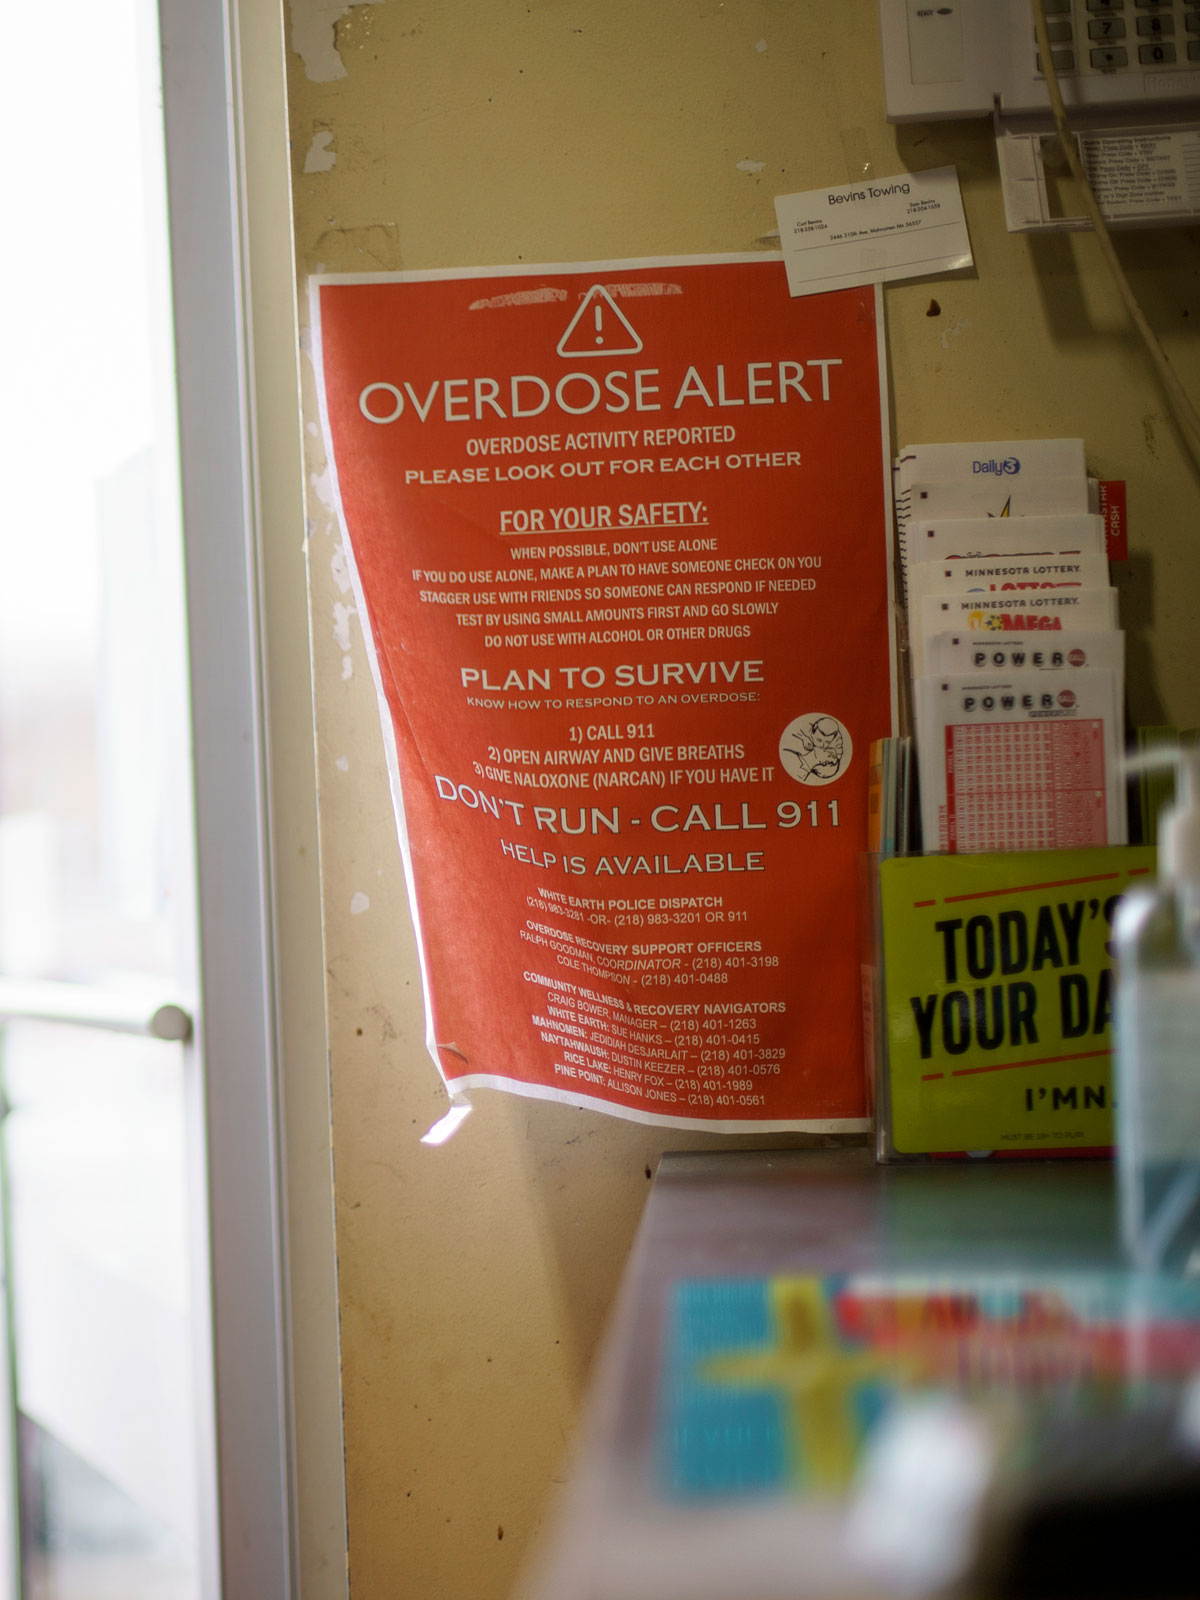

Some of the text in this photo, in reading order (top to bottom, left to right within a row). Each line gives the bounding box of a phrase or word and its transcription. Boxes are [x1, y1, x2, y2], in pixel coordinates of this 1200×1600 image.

[1103, 18, 1161, 34] 7 8
[828, 183, 911, 205] Bevins Towing
[359, 359, 842, 424] OVERDOSE ALERT
[466, 425, 735, 456] OVERDOSE ACTIVITY REPORTED
[405, 451, 801, 485] PLEASE LOOK OUT FOR EACH OTHER
[499, 501, 709, 535] FOR YOUR SAFETY:
[1110, 505, 1120, 536] CASH
[510, 538, 717, 560] WHEN POSSIBLE, DON'T USE ALONE
[412, 556, 821, 583] IF YOU DO USE ALONE, MAKE A PLAN TO HAVE SOMEONE CHECK ON YOU
[965, 567, 1030, 577] MINNESOTA
[420, 579, 816, 604] STAGGER USE WITH FRIENDS SO SOMEONE CAN RESPOND IF NEEDED
[961, 600, 1026, 610] MINNESOTA
[456, 602, 778, 626] TEST BY USING SMALL AMOUNTS FIRST AND GO SLOWLY
[485, 625, 751, 648] DO NOT USE WITH ALCOHOL OR OTHER DRUGS
[975, 652, 1064, 667] POWER
[461, 660, 764, 690] PLAN TO SURVIVE
[467, 692, 760, 709] KNOW HOW TO RESPOND TO AN OVERDOSE:
[964, 694, 1053, 711] POWER
[569, 723, 655, 744] 1) CALL 911
[488, 744, 744, 765] 2) OPEN AIRWAY AND GIVE BREATHS
[473, 761, 774, 790] 3) GIVE NALOXONE (NARCAN) IF YOU HAVE IT
[435, 775, 524, 825] DON'T
[534, 807, 619, 834] RUN
[651, 803, 766, 832] CALL
[777, 800, 838, 827] 911
[501, 839, 764, 875] HELP IS AVAILABLE
[527, 896, 547, 912] (218)
[614, 915, 644, 928] (218)
[647, 912, 700, 925] 983-3201
[705, 912, 724, 922] OR
[728, 911, 747, 922] 911
[538, 887, 722, 910] WHITE EARTH POLICE DISPATCH
[520, 930, 548, 947] RALPH
[597, 956, 681, 970] COORDINATOR
[692, 958, 722, 970] (218)
[725, 956, 779, 967] 401-3198
[526, 920, 762, 955] OVERDOSE RECOVERY SUPPORT OFFICERS
[523, 971, 576, 994] COMMUNITY
[578, 987, 624, 1009] WELLNESS
[633, 1004, 700, 1015] RECOVERY
[704, 1002, 786, 1014] NAVIGATORS
[909, 981, 1039, 1059] YOUR
